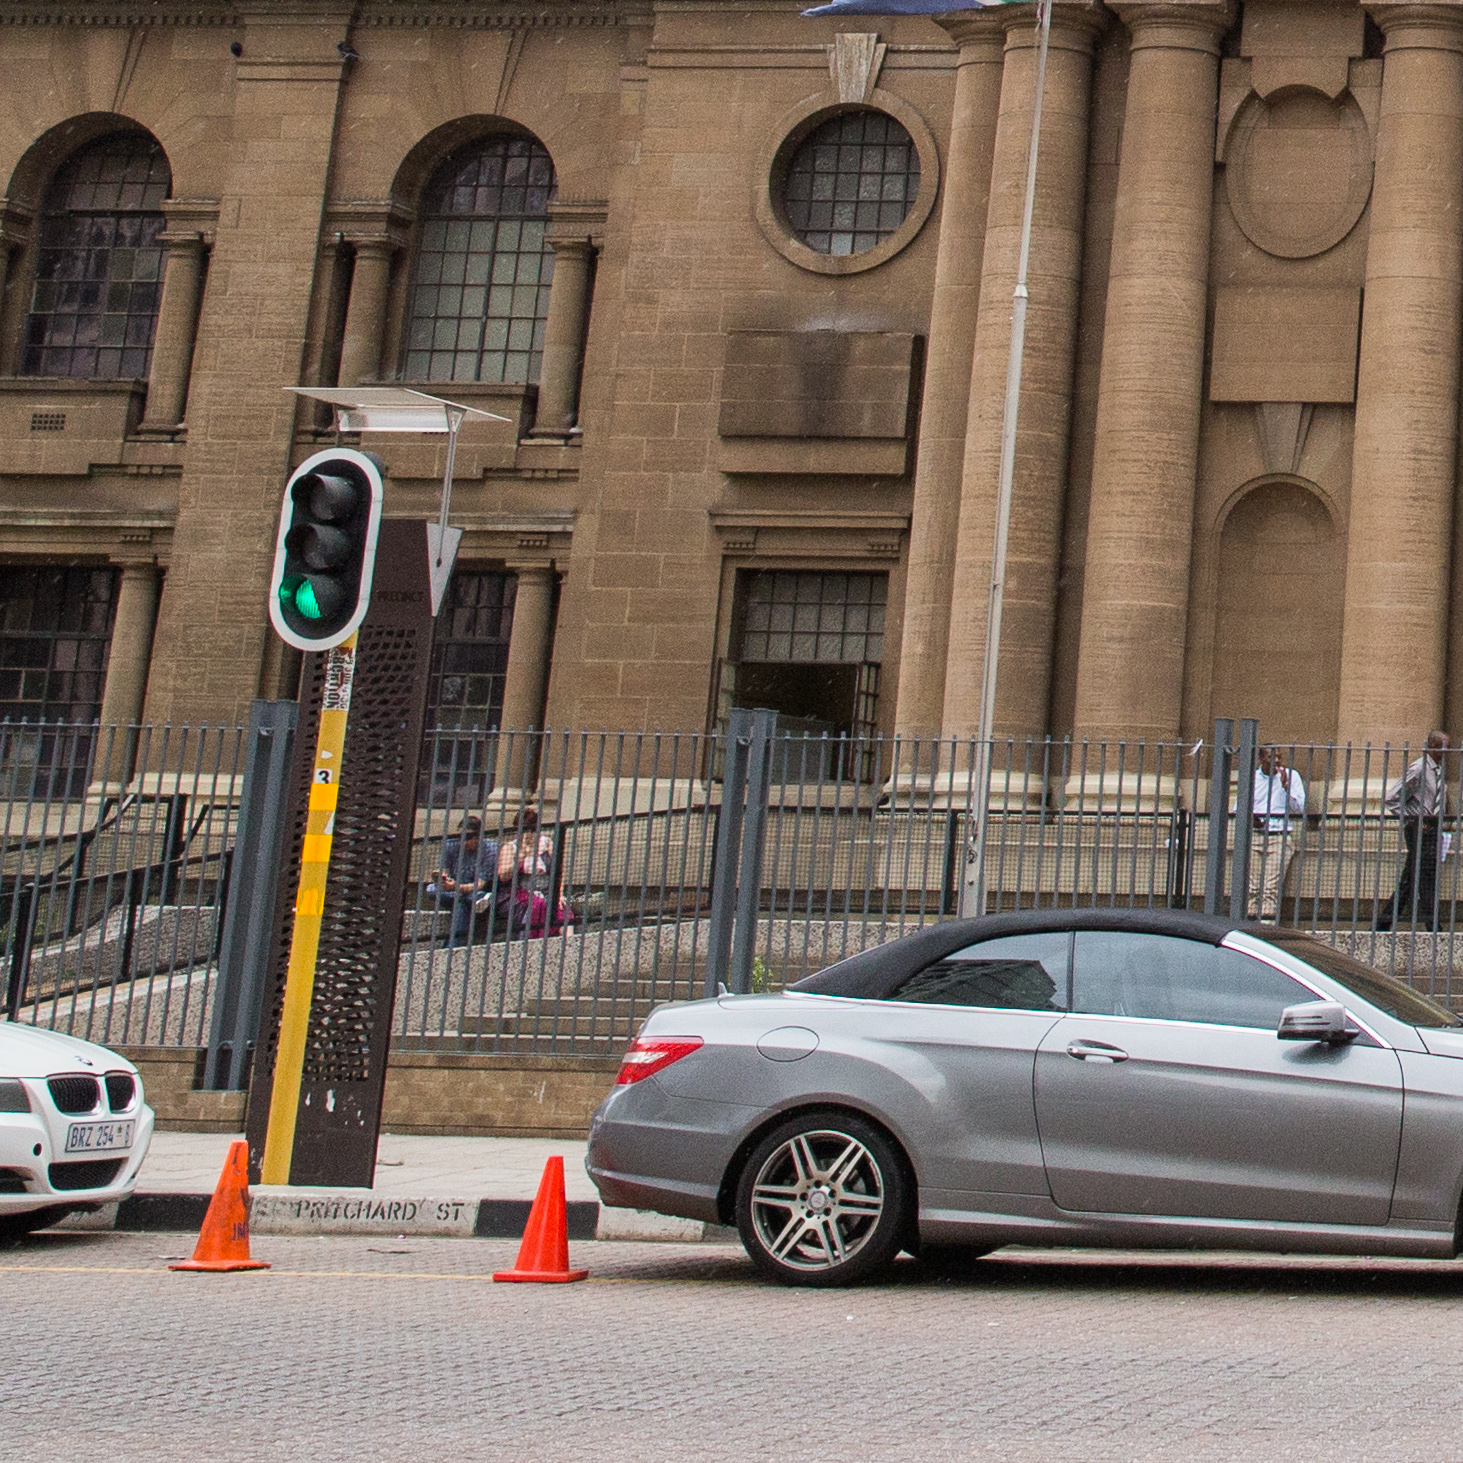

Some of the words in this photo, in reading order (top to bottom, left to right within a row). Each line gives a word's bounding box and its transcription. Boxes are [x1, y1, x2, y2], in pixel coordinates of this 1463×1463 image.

[71, 1126, 94, 1147] BRZ
[97, 1125, 114, 1147] 254
[294, 1200, 417, 1222] PRITCHARD
[436, 1202, 465, 1222] ST
